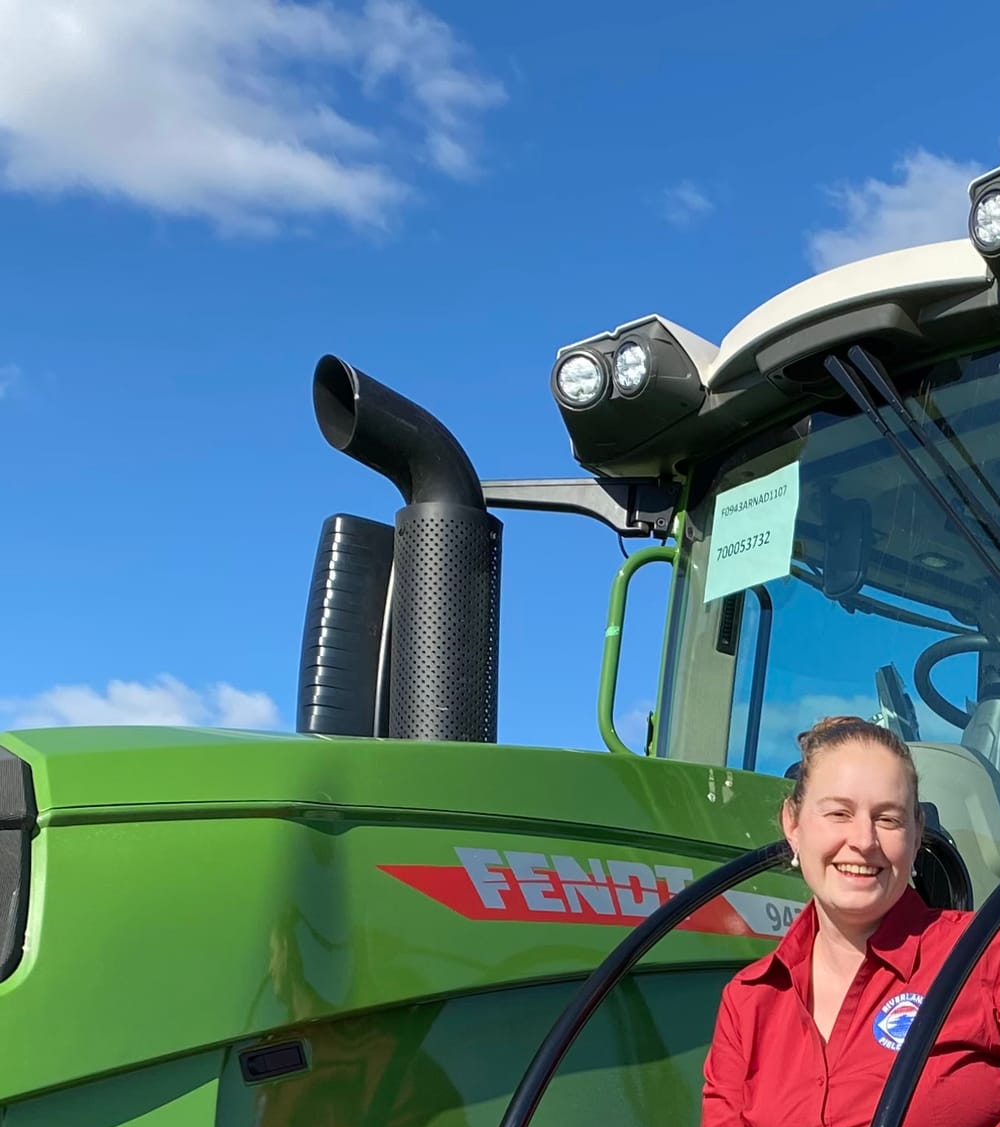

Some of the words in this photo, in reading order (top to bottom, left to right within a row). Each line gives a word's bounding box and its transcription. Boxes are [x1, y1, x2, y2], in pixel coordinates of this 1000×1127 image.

[716, 531, 771, 561] 700053732
[453, 847, 695, 920] FENDT
[765, 902, 802, 932] 94
